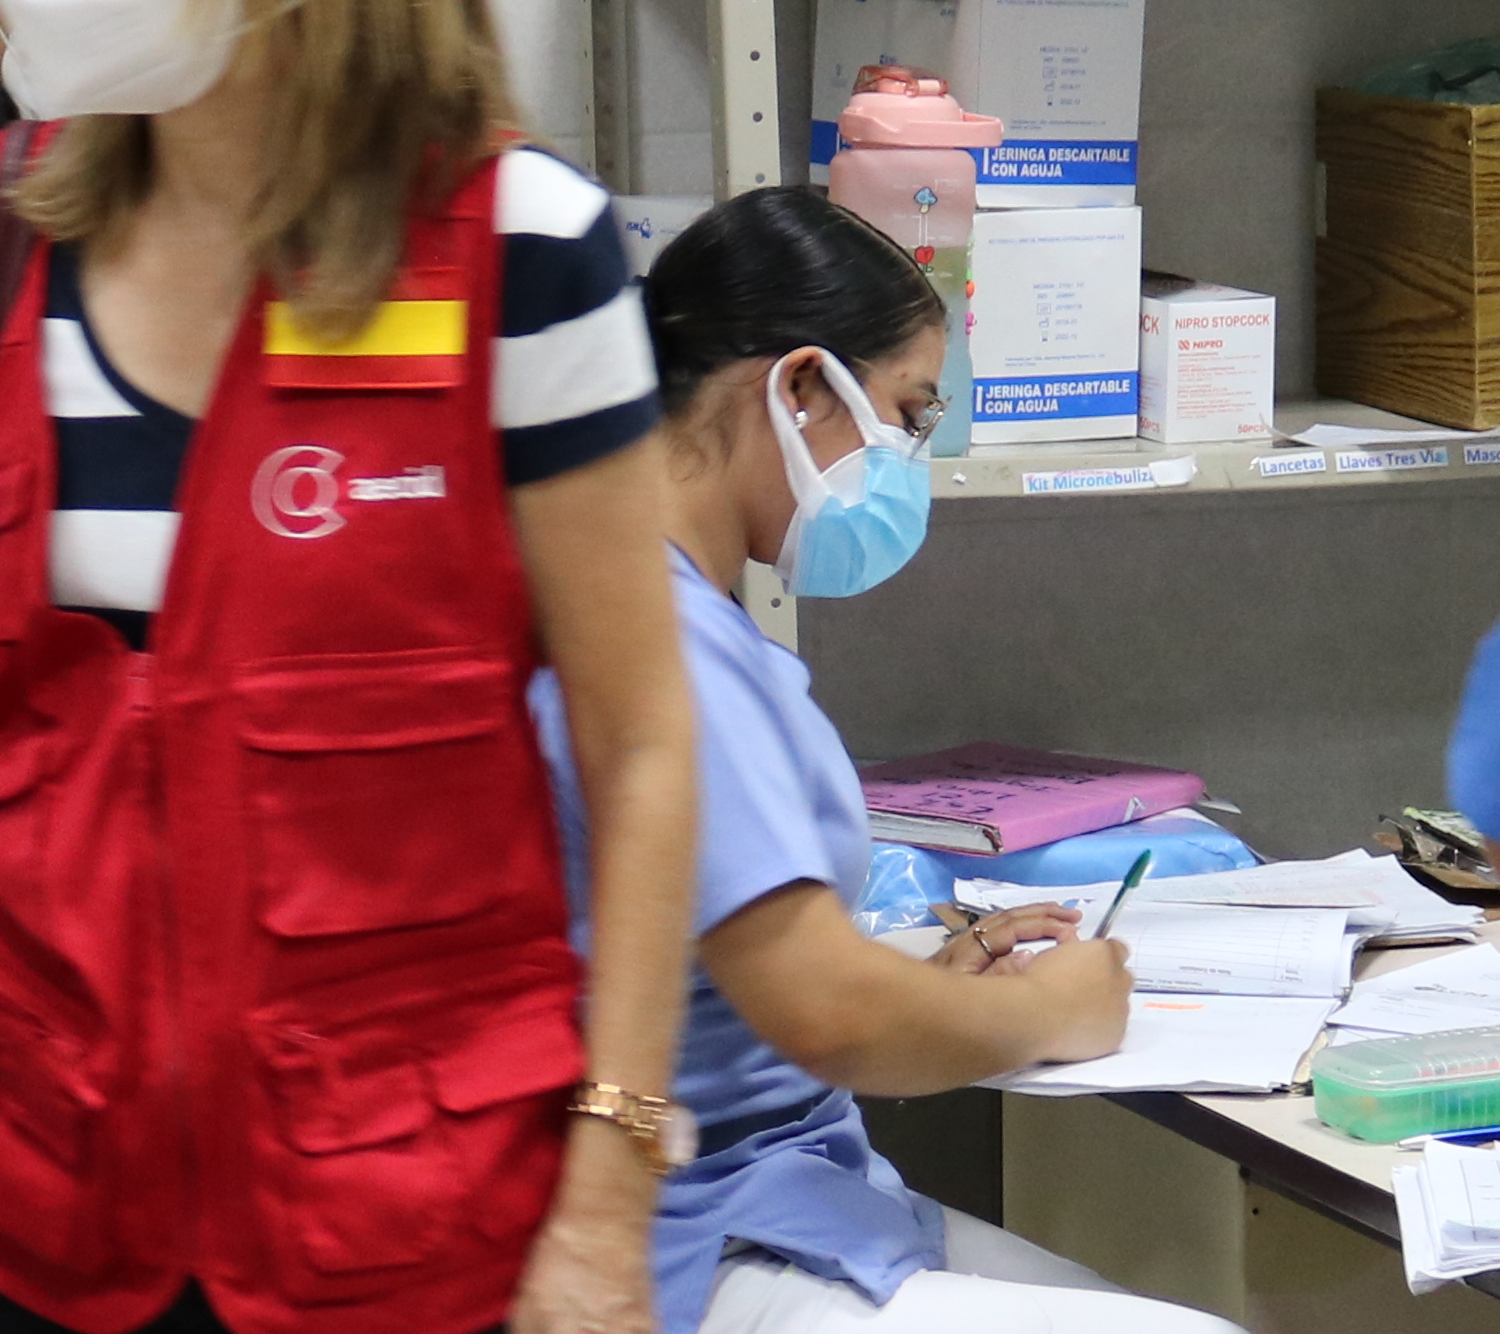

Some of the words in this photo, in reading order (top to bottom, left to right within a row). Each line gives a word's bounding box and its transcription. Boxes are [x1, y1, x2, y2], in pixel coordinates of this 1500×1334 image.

[992, 147, 1046, 164] JERINGA
[1048, 147, 1130, 164] DESCARTABLE
[991, 164, 1017, 178] CON
[1021, 162, 1063, 177] AGUJA
[1212, 314, 1270, 327] STOPCOCK
[986, 383, 1042, 398] JERINGA
[1045, 380, 1130, 396] DESCARTABLE
[985, 401, 1013, 413] CON
[1016, 400, 1058, 412] AGUJA
[1262, 456, 1324, 474] Lancetas
[1339, 452, 1382, 469] Llaves
[1386, 449, 1416, 466] Tres
[1028, 477, 1048, 492] Kit
